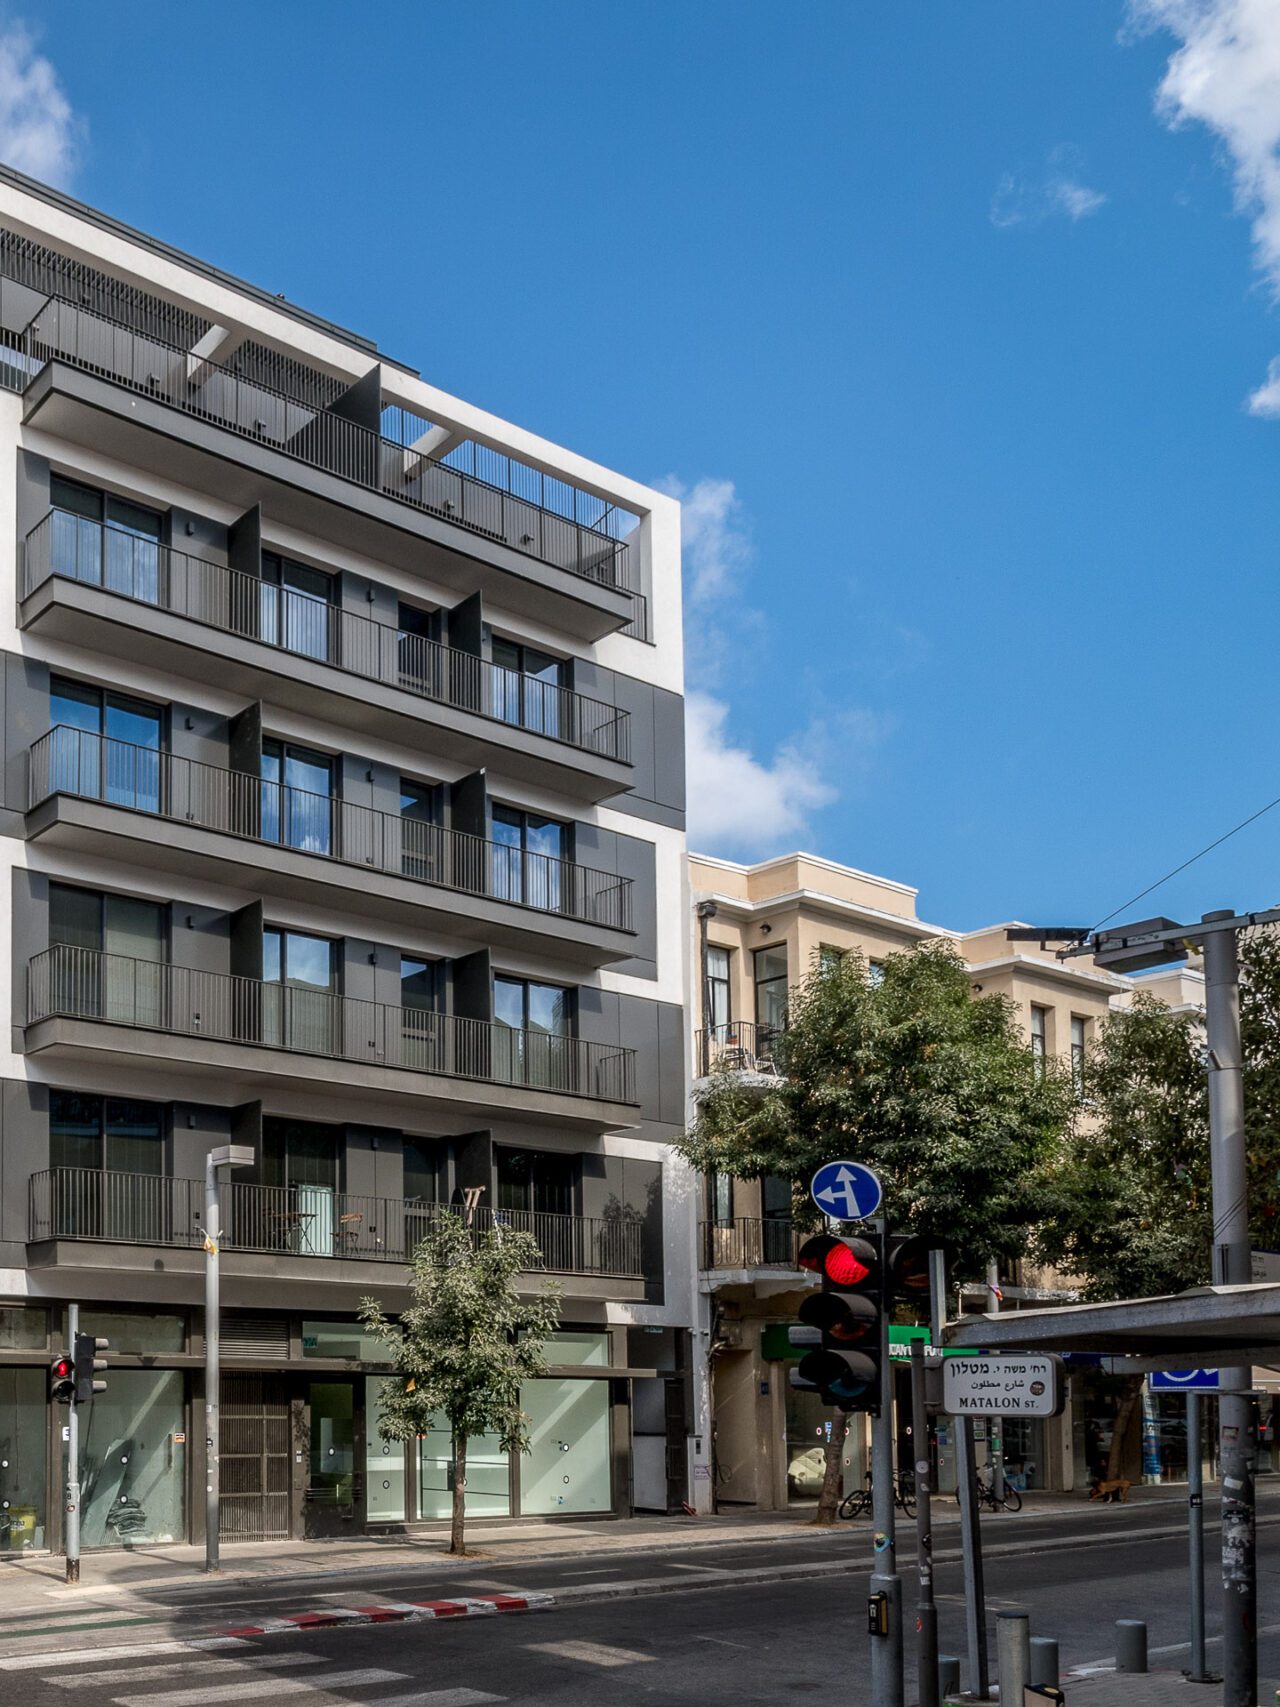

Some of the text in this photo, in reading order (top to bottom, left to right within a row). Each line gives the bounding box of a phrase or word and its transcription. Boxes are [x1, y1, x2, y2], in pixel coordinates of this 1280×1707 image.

[950, 1361, 990, 1378] מטלון
[1004, 1365, 1027, 1374] משה
[1030, 1365, 1047, 1374] רח'
[970, 1379, 1025, 1392] شارع مطلون
[959, 1397, 1039, 1409] MATALON ST.
